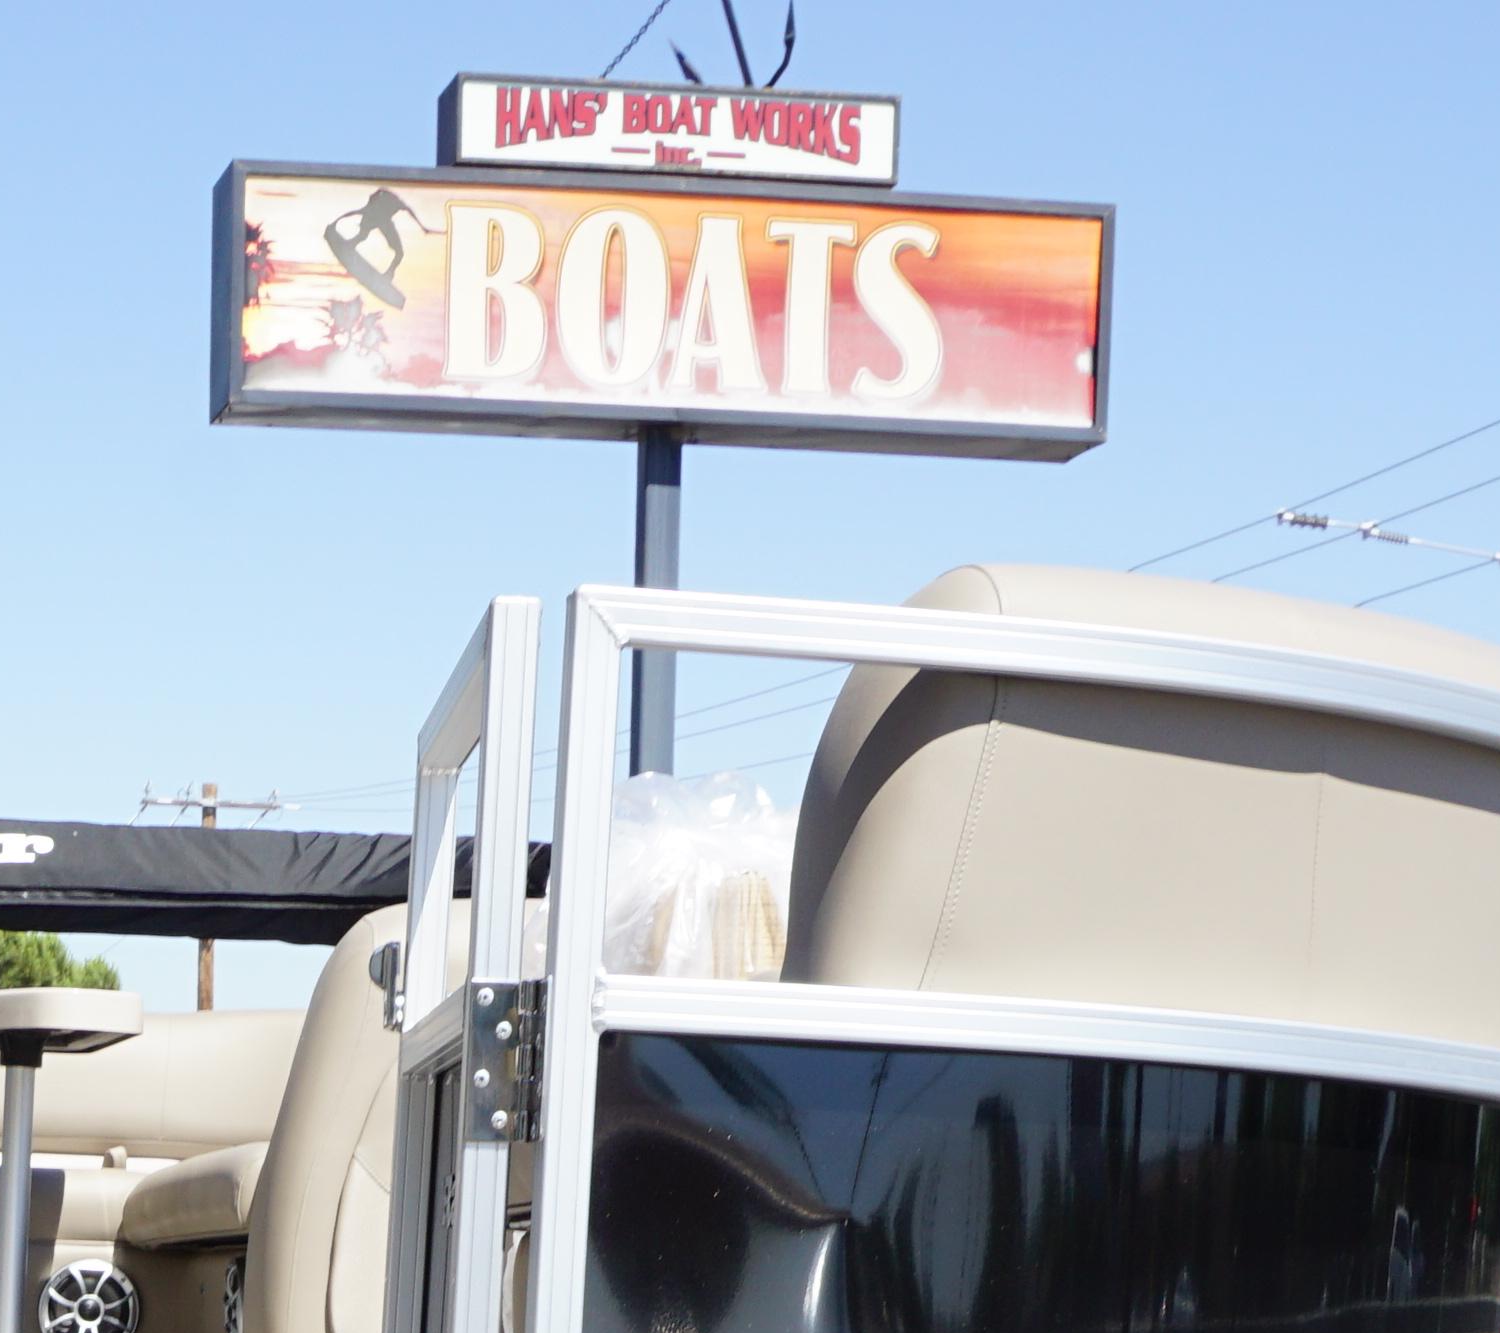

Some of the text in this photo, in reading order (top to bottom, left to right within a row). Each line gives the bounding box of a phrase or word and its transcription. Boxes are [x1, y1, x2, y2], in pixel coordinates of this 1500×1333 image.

[495, 87, 862, 165] HANS' BOAT WORKS
[441, 199, 943, 401] BOATS
